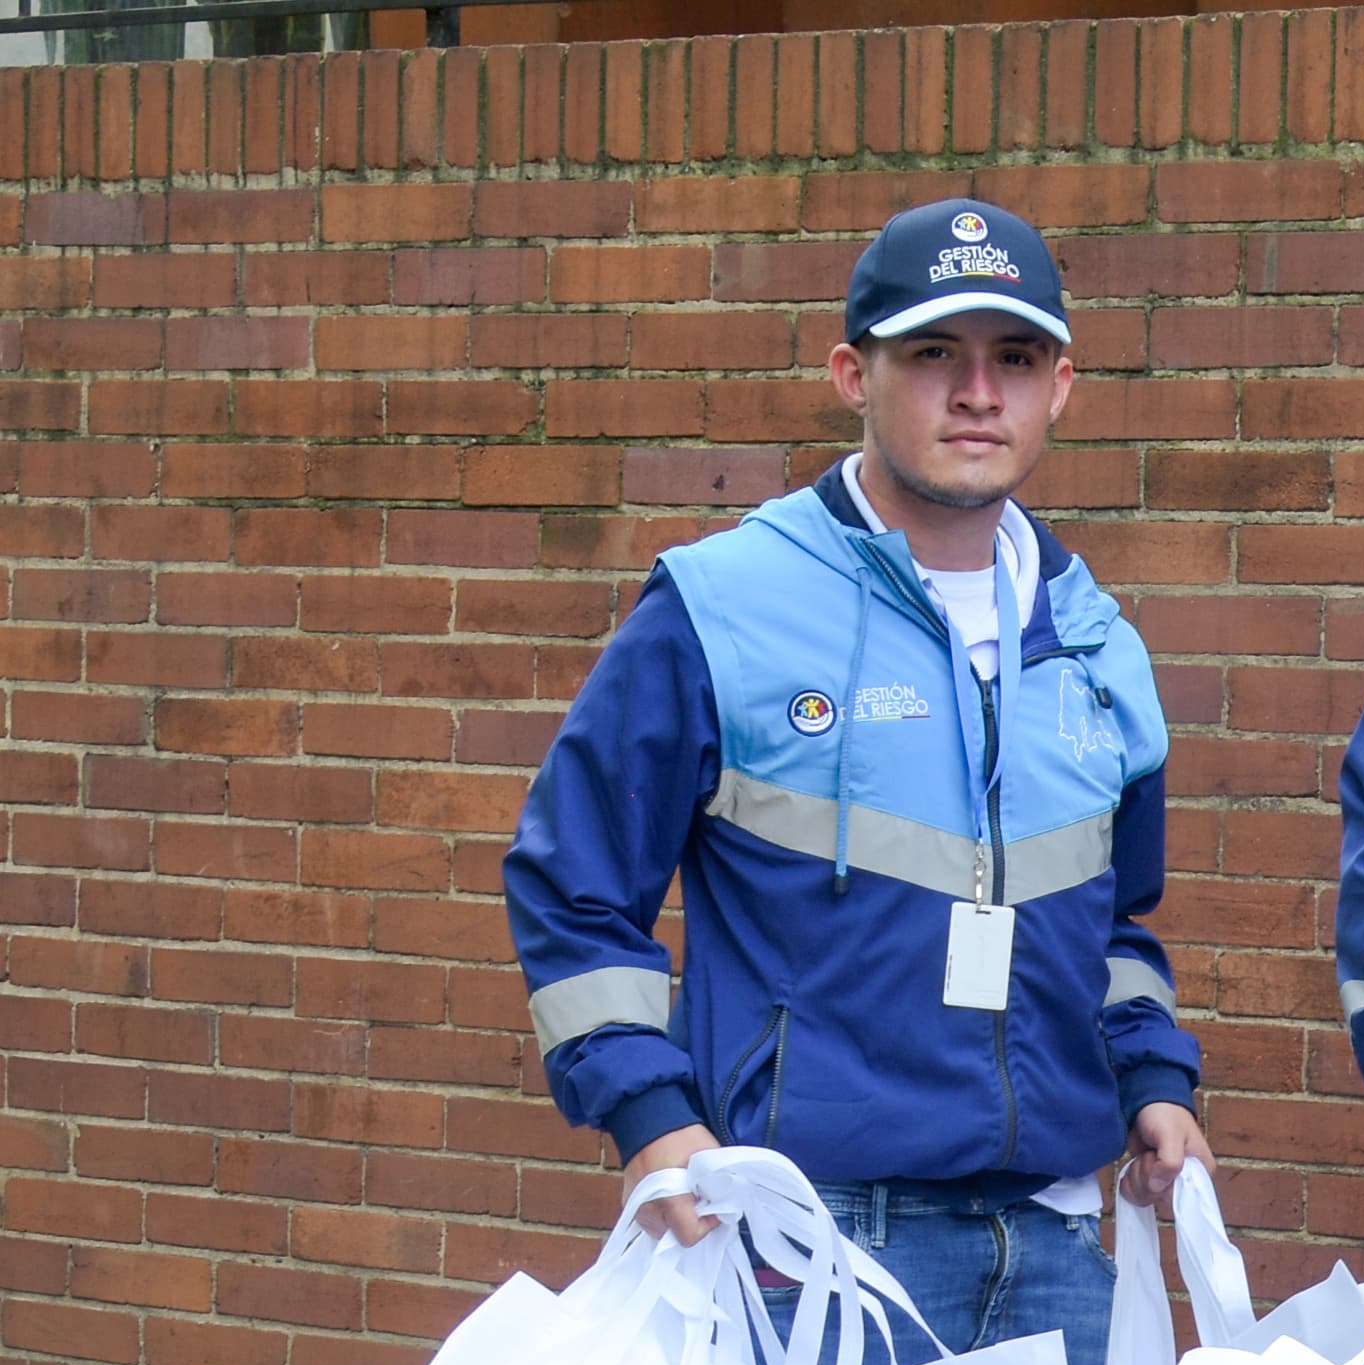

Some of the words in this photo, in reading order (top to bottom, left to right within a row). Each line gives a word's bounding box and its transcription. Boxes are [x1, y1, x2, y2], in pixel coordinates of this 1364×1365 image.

[939, 243, 1009, 264] GESTIÓN
[929, 262, 958, 279] DEL
[961, 259, 1020, 278] RIESGO
[872, 699, 928, 716] RIESGO
